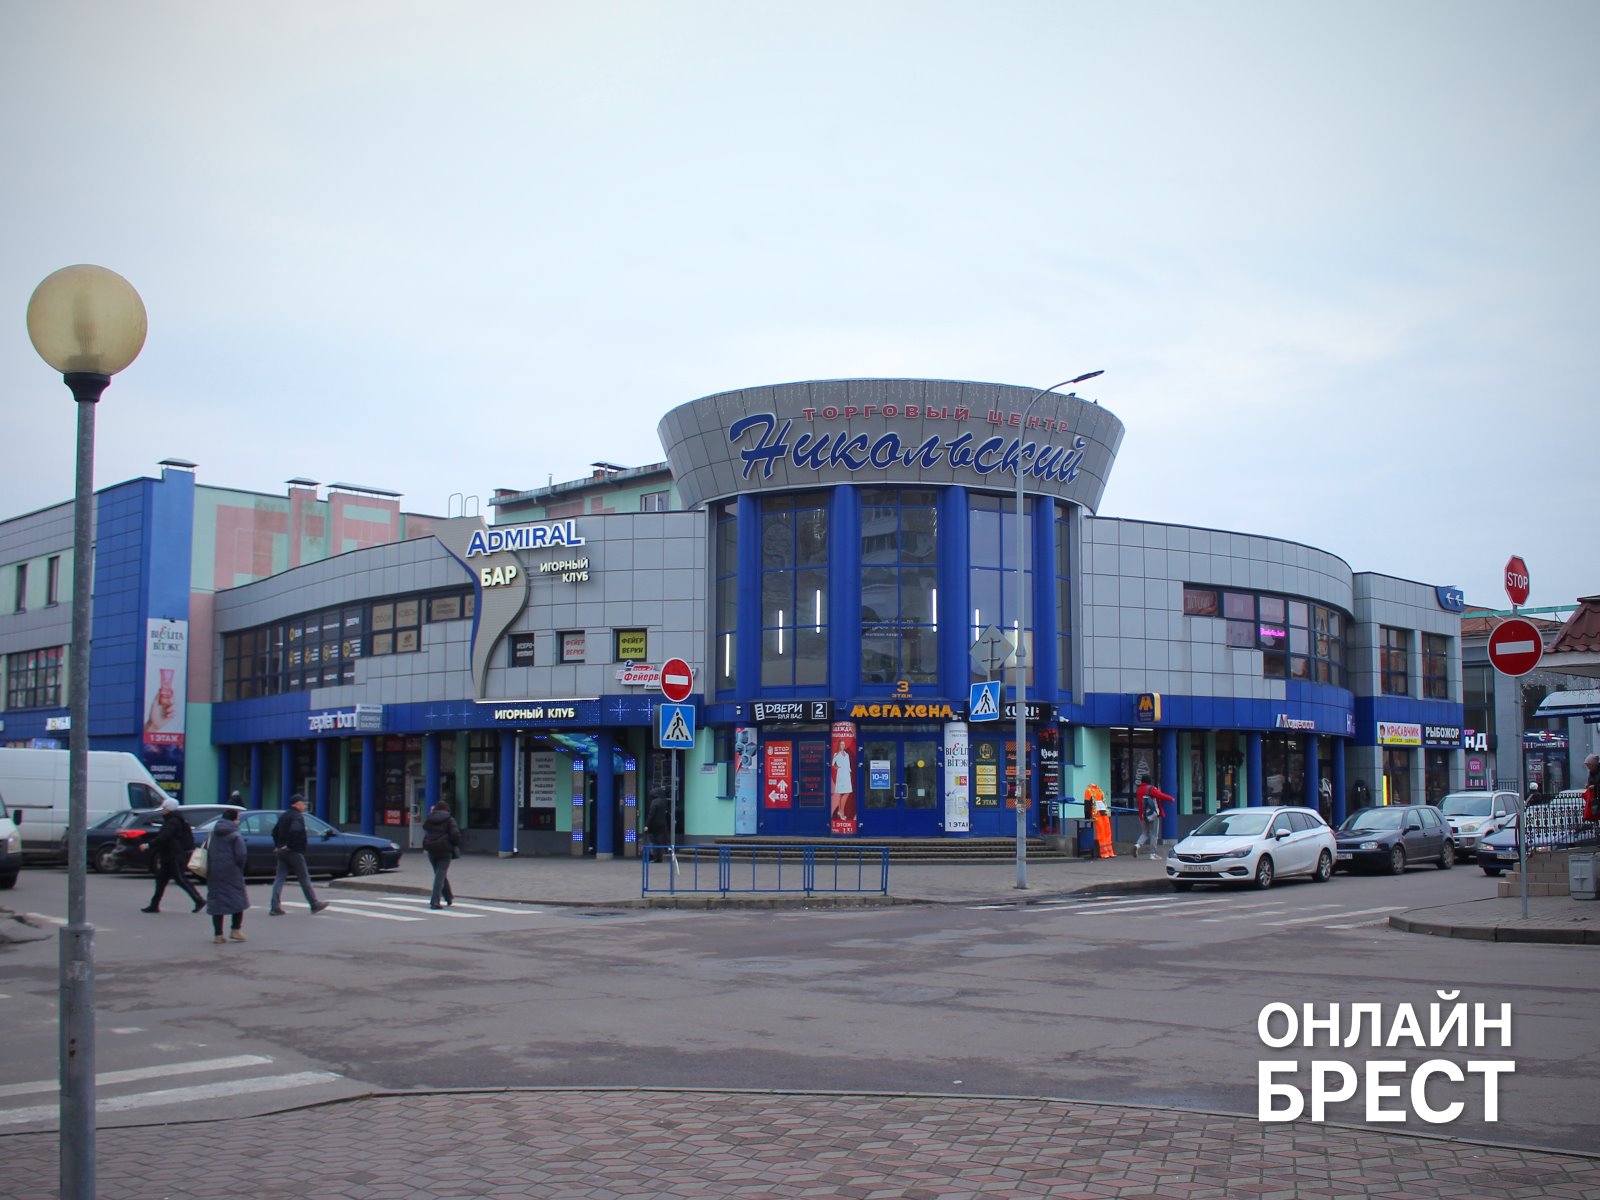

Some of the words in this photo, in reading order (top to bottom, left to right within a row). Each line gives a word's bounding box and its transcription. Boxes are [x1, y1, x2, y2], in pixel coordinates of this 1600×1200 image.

[803, 404, 970, 422] ТОРГОВЫЙ
[987, 411, 1069, 433] ЦЕНТР
[729, 412, 1087, 485] Никольский
[467, 519, 586, 557] ADMIRAL
[540, 558, 589, 573] ИГОРНЫЙ
[481, 565, 517, 588] БАР
[562, 573, 589, 583] КЛУБ
[1507, 572, 1529, 590] STOP
[624, 672, 660, 683] Фейерв
[897, 680, 909, 693] 3
[495, 706, 544, 719] ИГОРНЫЙ
[548, 707, 575, 718] КЛУБ
[765, 703, 803, 713] ДВЕРИ
[815, 703, 824, 714] 2
[1425, 726, 1459, 739] РЫБОЖОР
[976, 796, 982, 805] 2
